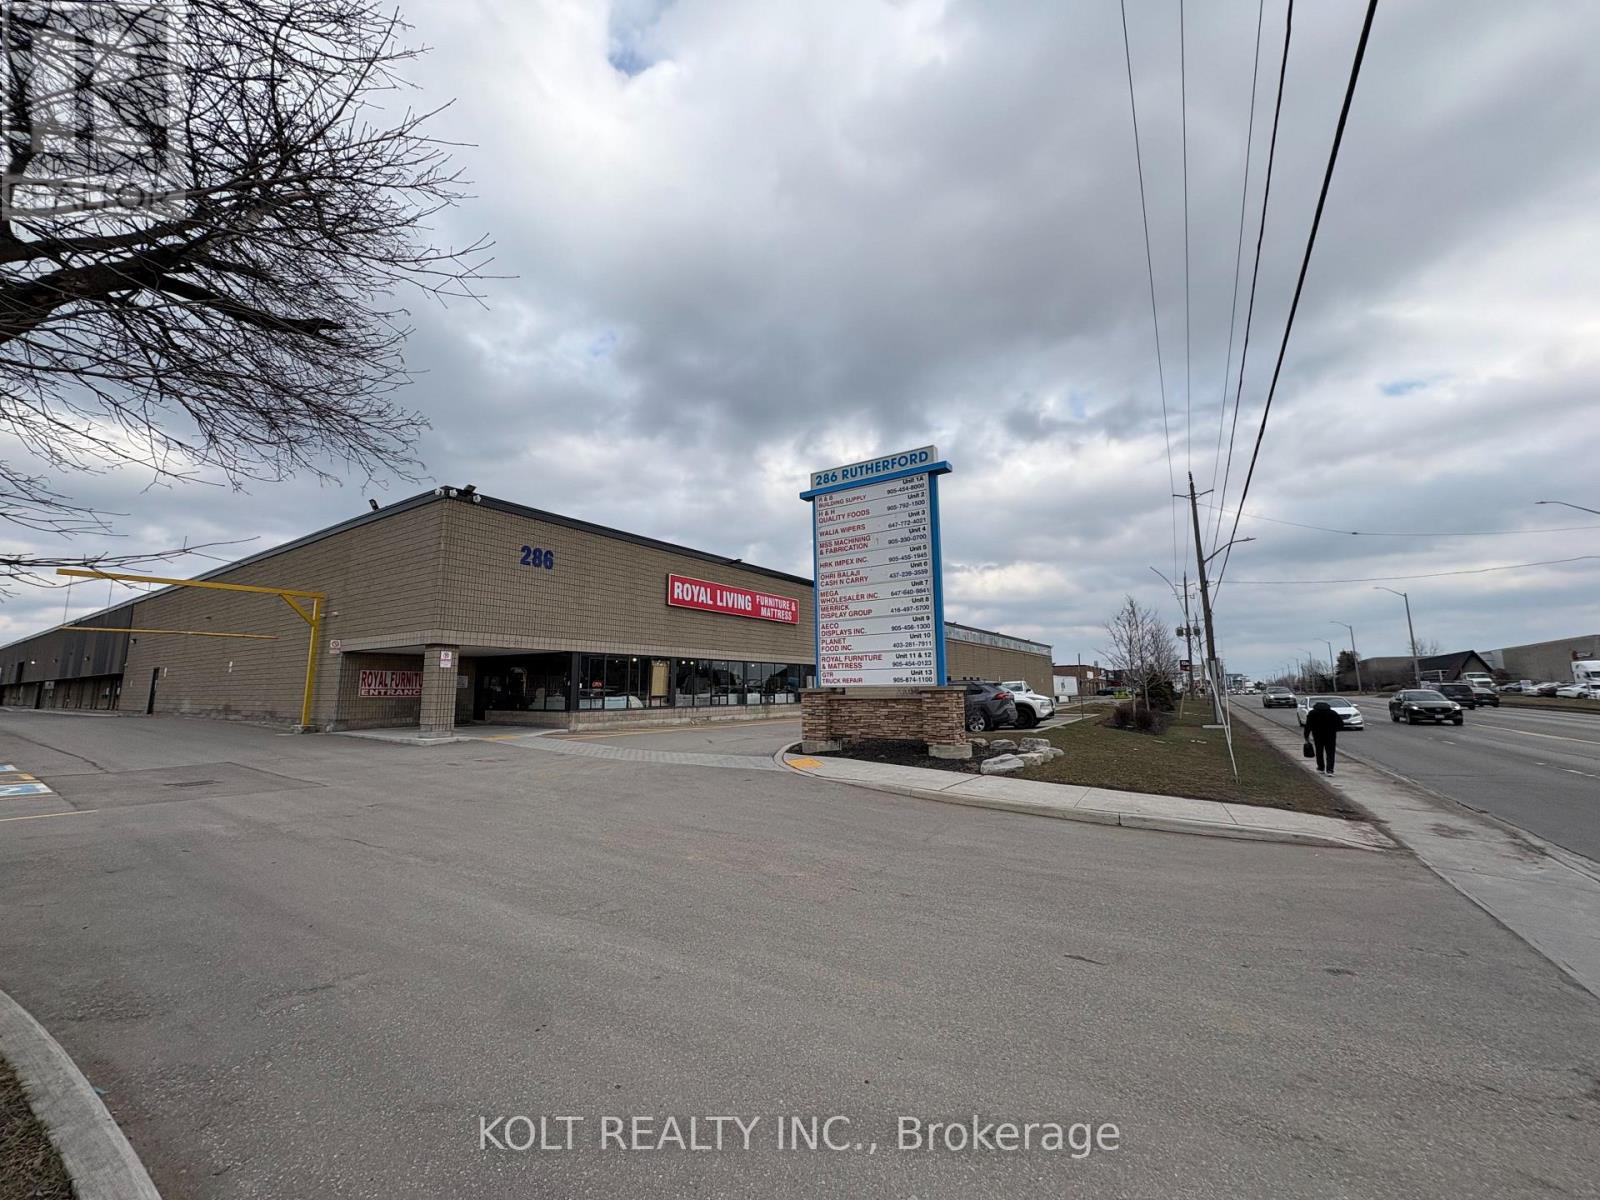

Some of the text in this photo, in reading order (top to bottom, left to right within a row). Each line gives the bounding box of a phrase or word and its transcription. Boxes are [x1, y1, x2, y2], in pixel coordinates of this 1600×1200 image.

[815, 450, 929, 486] 286 RUTHERFORD
[846, 494, 866, 504] SUPPLY
[818, 508, 870, 524] QUALITY FOODS
[819, 524, 866, 536] WALIA WIPERS
[834, 534, 871, 546] MACHINING
[825, 542, 868, 554] FABRICATION
[520, 544, 554, 570] 286
[834, 558, 854, 568] IMPEX
[820, 579, 838, 587] CASH
[845, 576, 869, 584] CARRY
[674, 581, 752, 611] ROYAL LIVING
[820, 594, 865, 604] WHOLESALER
[756, 594, 796, 611] FURNITURE &
[820, 604, 850, 612] MERRICK
[760, 608, 792, 620] MATTRESS
[820, 608, 873, 620] DISPLAY GROUP
[821, 629, 852, 637] DISPLAYS
[821, 637, 846, 645] PLANET
[361, 671, 389, 689] ROYAL
